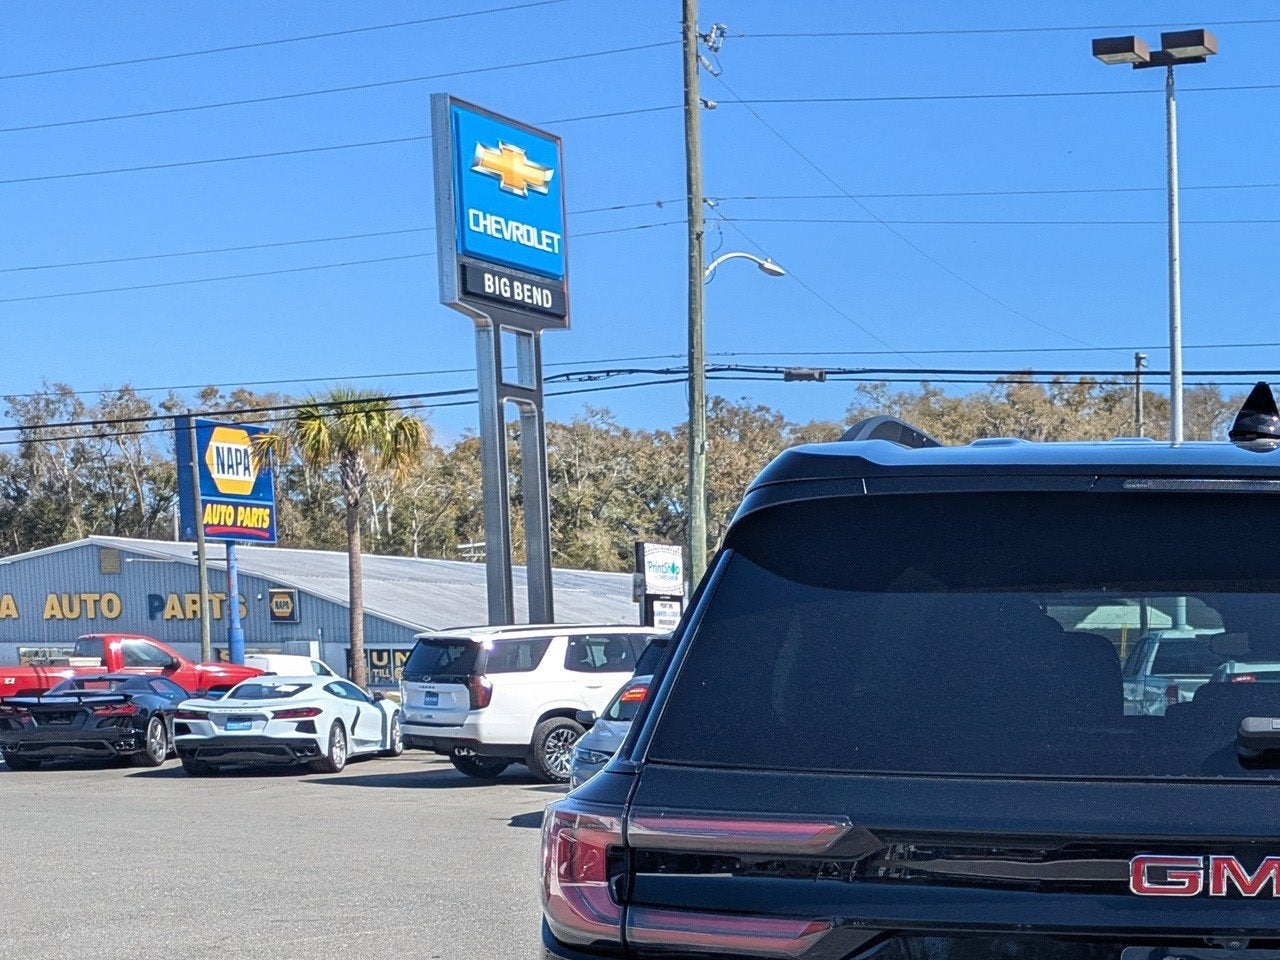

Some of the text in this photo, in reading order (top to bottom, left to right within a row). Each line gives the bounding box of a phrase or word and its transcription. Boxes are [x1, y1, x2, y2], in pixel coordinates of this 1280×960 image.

[469, 208, 561, 254] CHEVROLET
[484, 273, 553, 308] BIG BEND
[215, 445, 252, 477] NAPA
[203, 503, 270, 529] AUTO PARTS
[43, 592, 122, 620] AUTO
